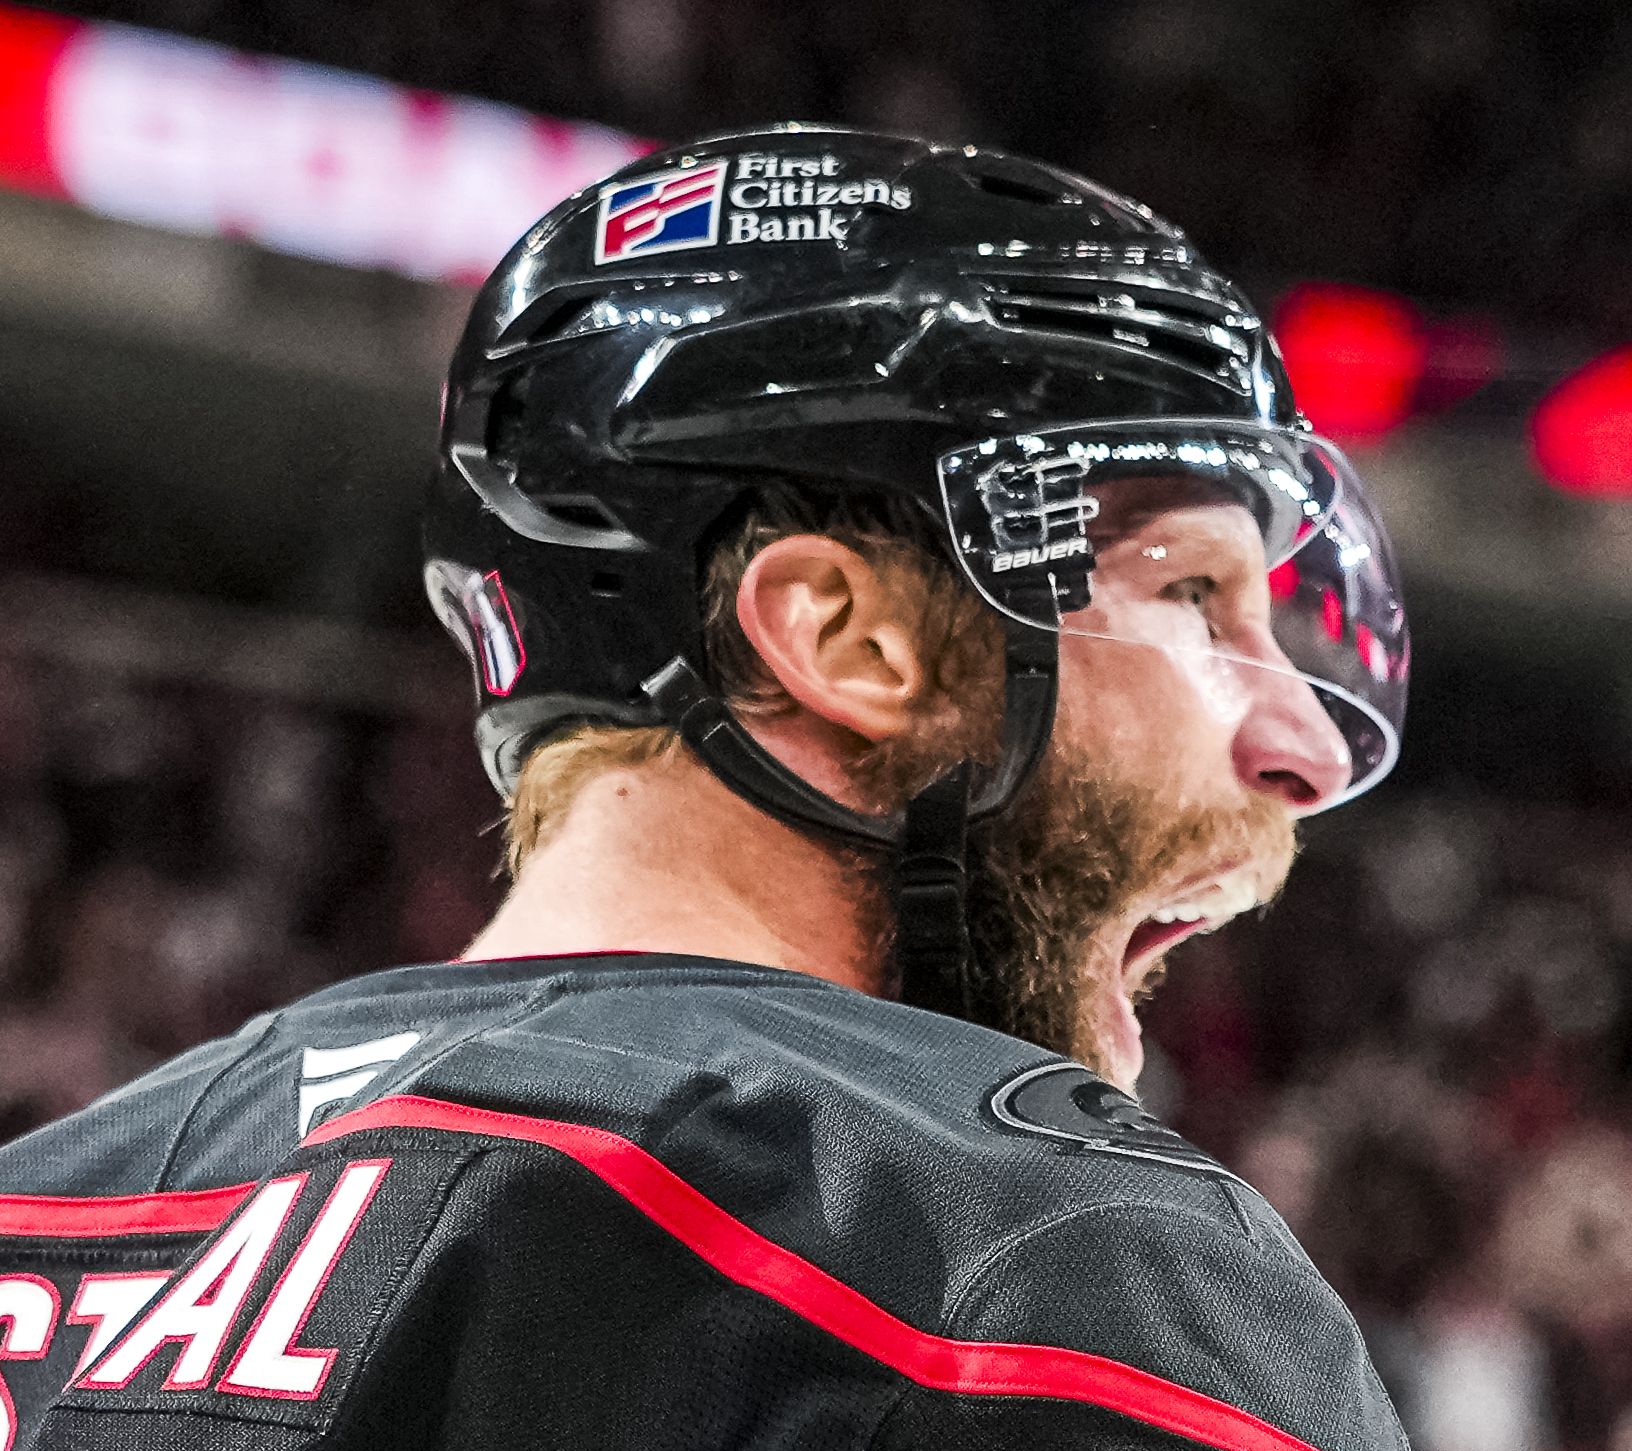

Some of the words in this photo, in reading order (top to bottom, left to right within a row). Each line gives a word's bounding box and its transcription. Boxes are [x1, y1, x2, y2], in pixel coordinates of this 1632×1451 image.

[734, 152, 842, 180] First
[728, 177, 913, 211] Citizens
[725, 207, 851, 246] Bank
